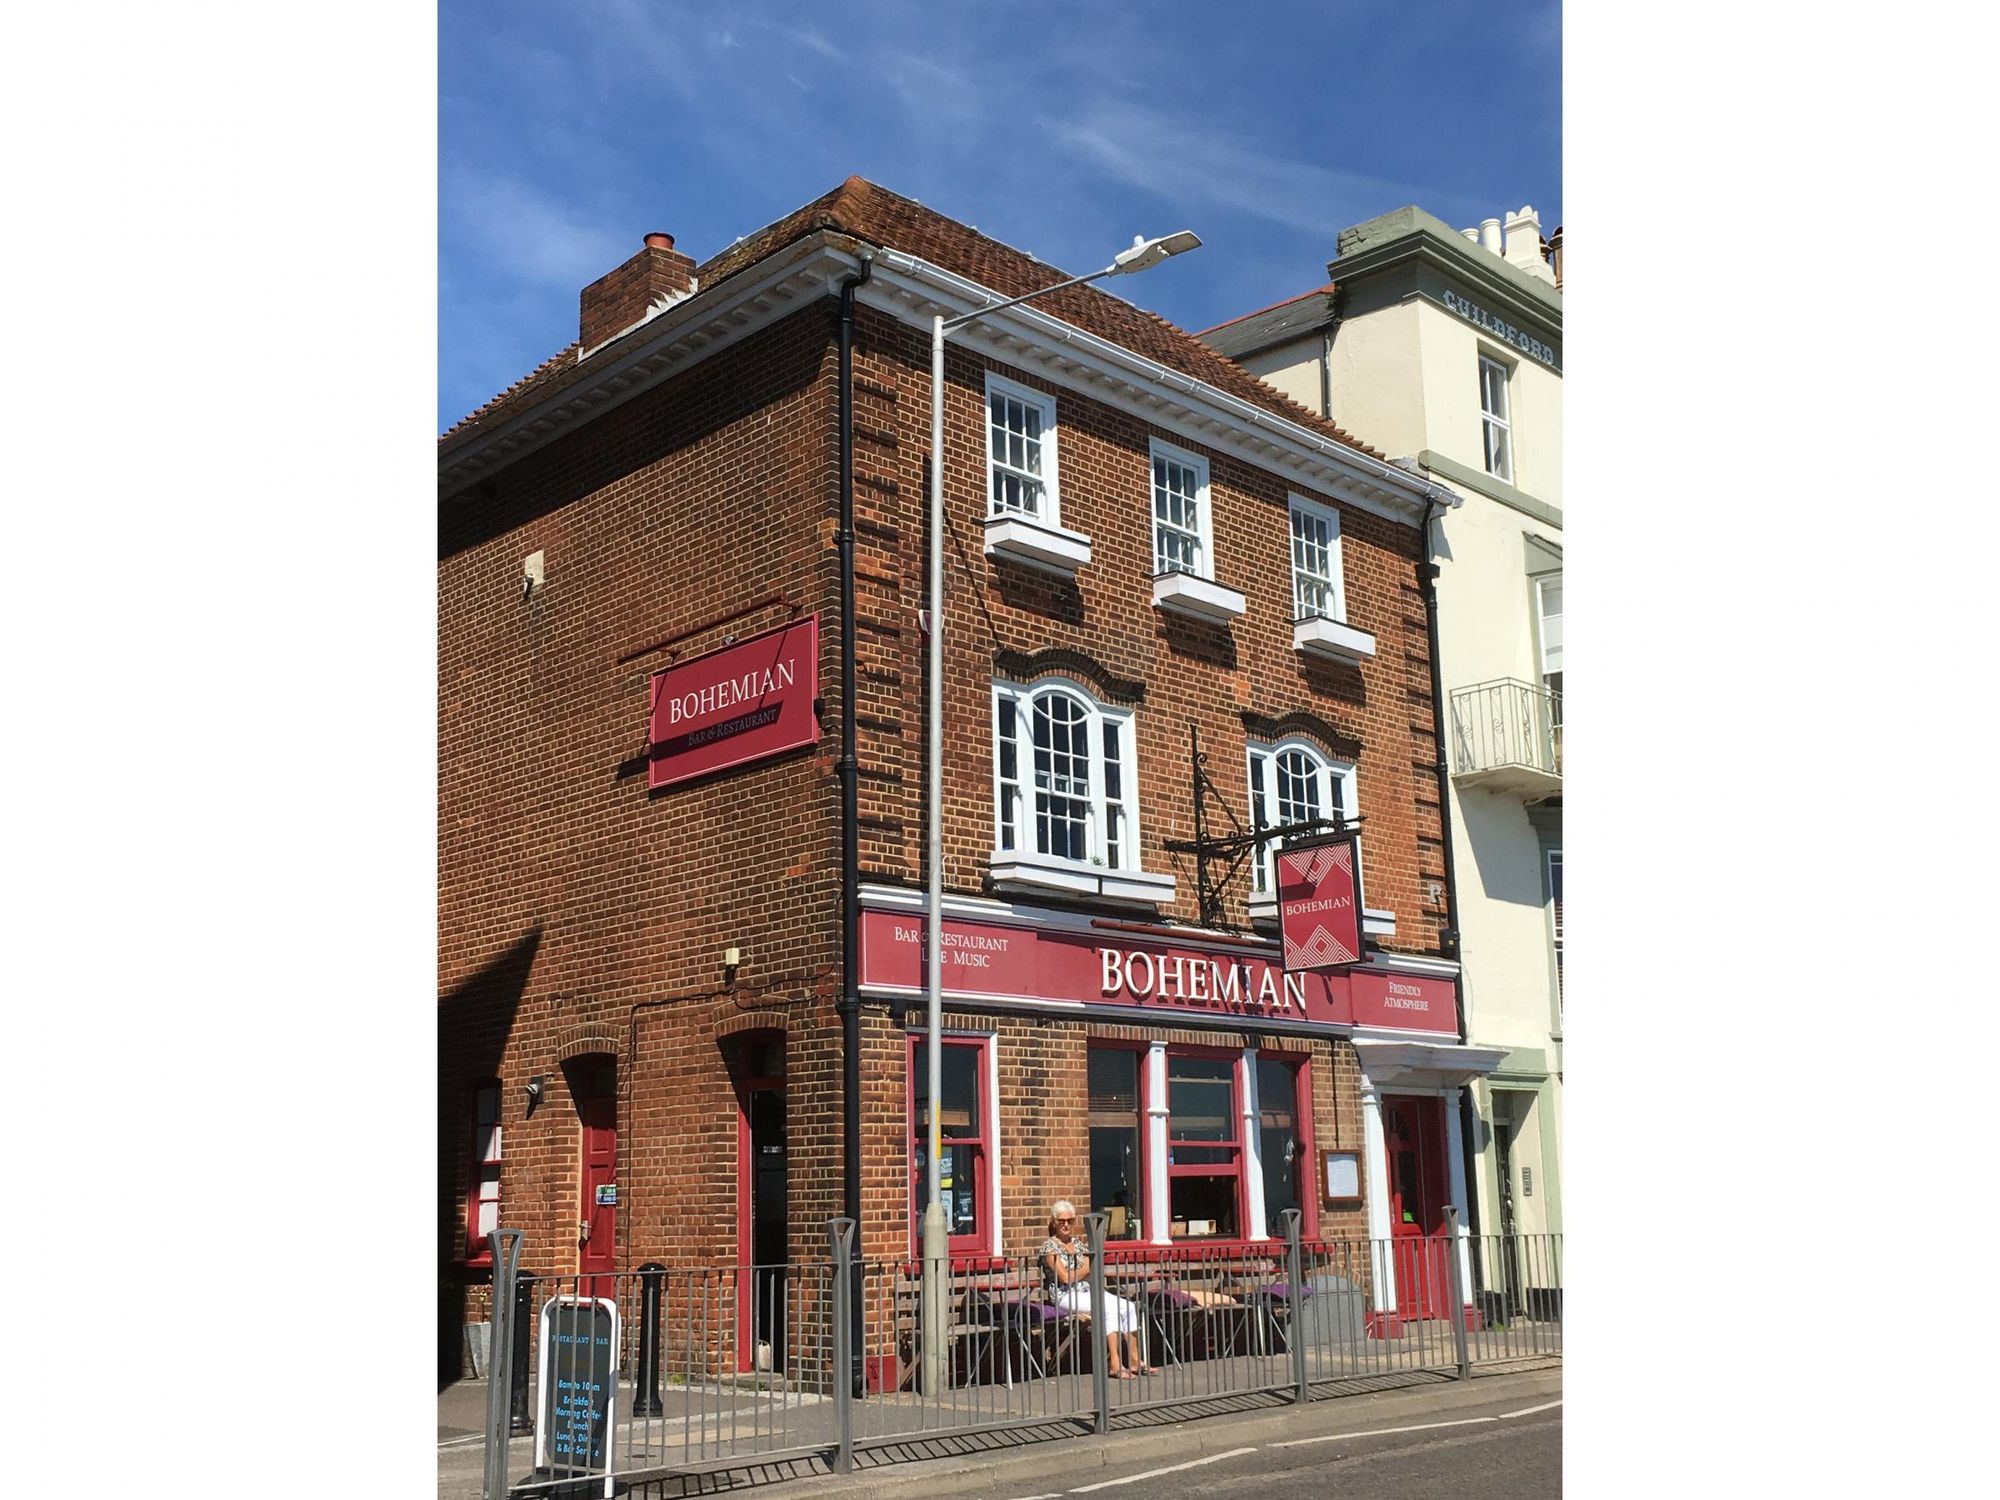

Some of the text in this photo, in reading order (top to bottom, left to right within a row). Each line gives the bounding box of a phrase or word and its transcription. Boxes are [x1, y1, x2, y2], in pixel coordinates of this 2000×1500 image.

[669, 658, 795, 725] BOHEMIAN
[688, 708, 777, 747] BAR & RESTAURANT
[1286, 895, 1352, 917] BOHEMIAN
[894, 926, 919, 943] BAR
[921, 946, 991, 968] LE MUSIC
[1099, 948, 1307, 1010] BOHEMIAN
[1388, 981, 1422, 997] FRIENDLY
[1383, 996, 1430, 1011] ATMOSPHERE
